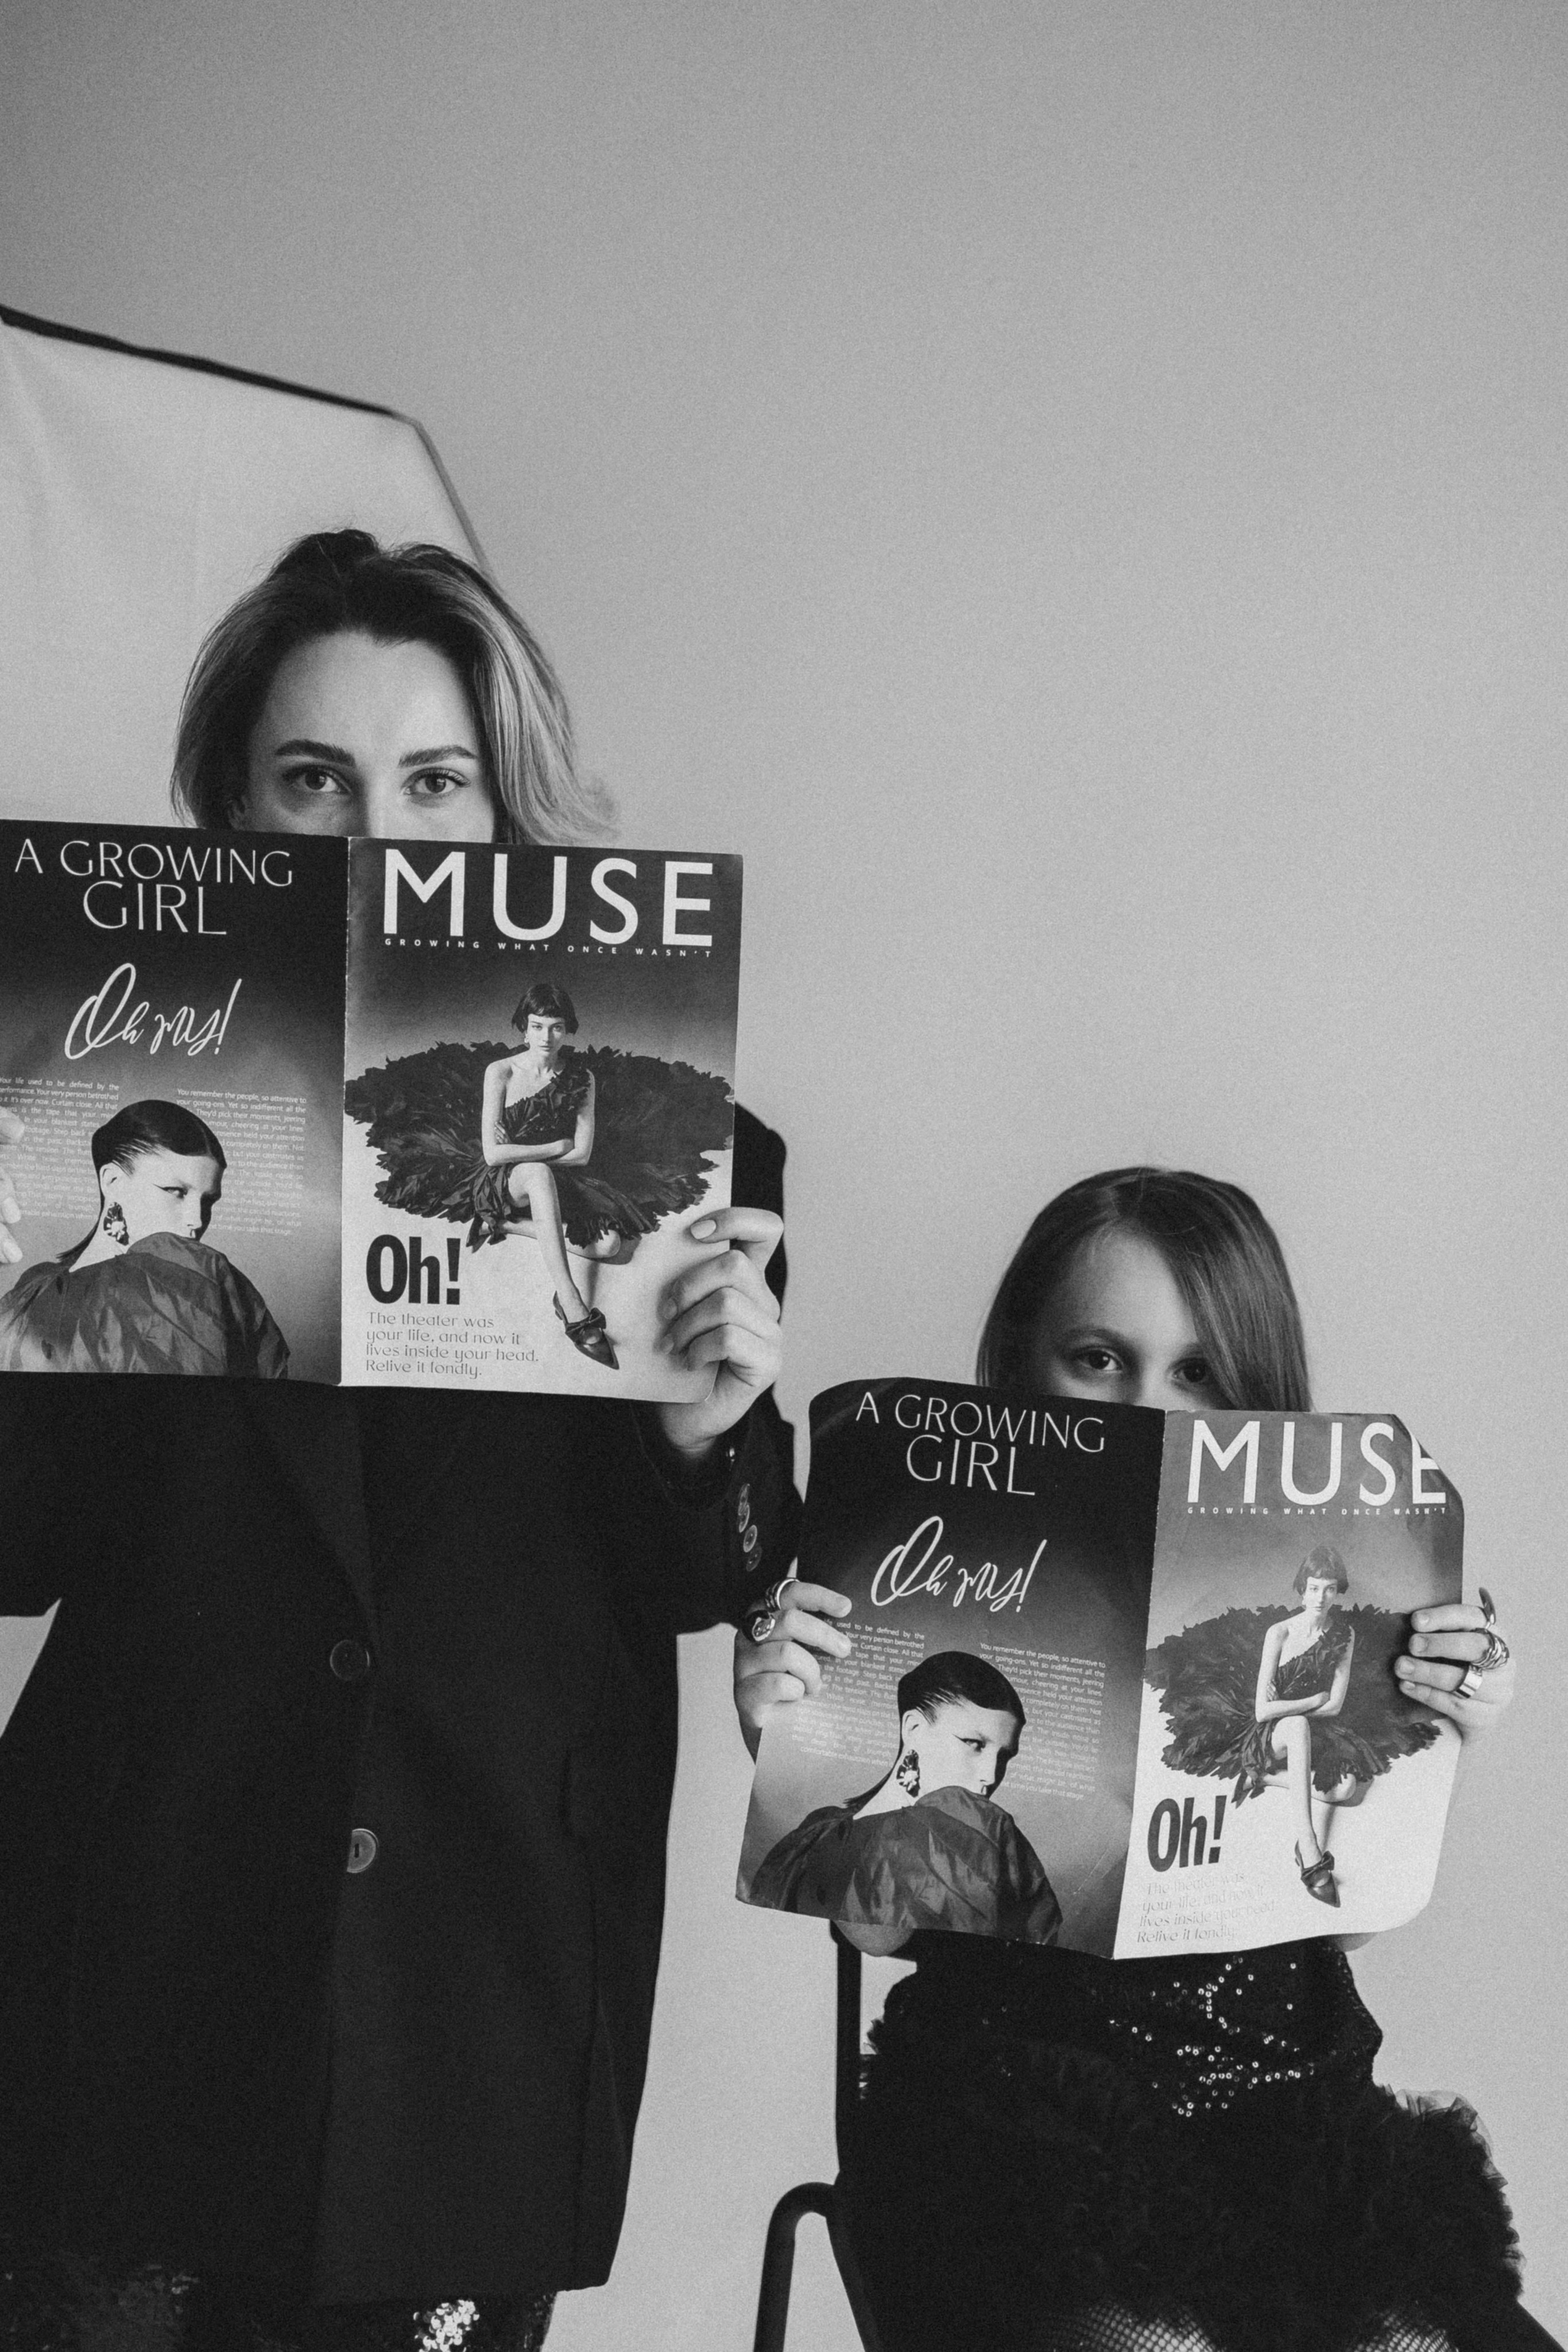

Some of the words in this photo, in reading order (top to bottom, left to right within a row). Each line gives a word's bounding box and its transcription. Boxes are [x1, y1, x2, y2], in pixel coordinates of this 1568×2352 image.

[15, 839, 43, 873] A
[60, 840, 292, 886] GROWING
[383, 848, 713, 946] MUSE
[83, 881, 227, 935] GIRL
[385, 939, 480, 948] GROWING
[498, 943, 549, 952] WHAT
[567, 946, 617, 954] ONCE
[635, 948, 710, 958] WASN'T
[65, 963, 149, 1060] Oh
[197, 1109, 216, 1118] They'd
[284, 1116, 305, 1125] jeering
[366, 1234, 461, 1305] Oh!
[369, 1312, 396, 1324] The
[401, 1313, 458, 1326] theater
[464, 1318, 494, 1328] was
[366, 1330, 402, 1343] your
[408, 1329, 434, 1343] life,
[439, 1332, 468, 1343] and
[473, 1335, 506, 1344] now
[511, 1333, 519, 1345] it
[366, 1344, 399, 1356] lives
[405, 1344, 448, 1358] inside
[455, 1350, 491, 1363] your
[496, 1349, 539, 1362] head.
[366, 1360, 411, 1373] Relive
[417, 1361, 425, 1373] it
[431, 1362, 481, 1379] fondly.
[856, 1392, 879, 1423] A
[895, 1395, 1104, 1452] GROWING
[907, 1434, 1035, 1495] GIRL
[1187, 1420, 1446, 1506] MUSE
[870, 1516, 954, 1606] Oh
[876, 1627, 899, 1636] defined
[861, 1643, 882, 1651] Curtain
[894, 1639, 924, 1649] betrothed
[993, 1646, 1025, 1655] remember
[1038, 1653, 1060, 1662] people,
[1071, 1658, 1098, 1667] attentive
[995, 1656, 1027, 1665] going-ons.
[1051, 1664, 1082, 1673] indifferent
[998, 1664, 1018, 1673] They'd
[1050, 1674, 1080, 1684] moments,
[1082, 1679, 1104, 1689] jeering
[1147, 1795, 1227, 1872] Oh!
[1148, 1882, 1169, 1895] The
[1142, 1901, 1172, 1914] your
[1140, 1915, 1170, 1927] lives
[1174, 1911, 1211, 1925] inside
[1137, 1929, 1178, 1943] Relive
[1183, 1928, 1190, 1940] it
